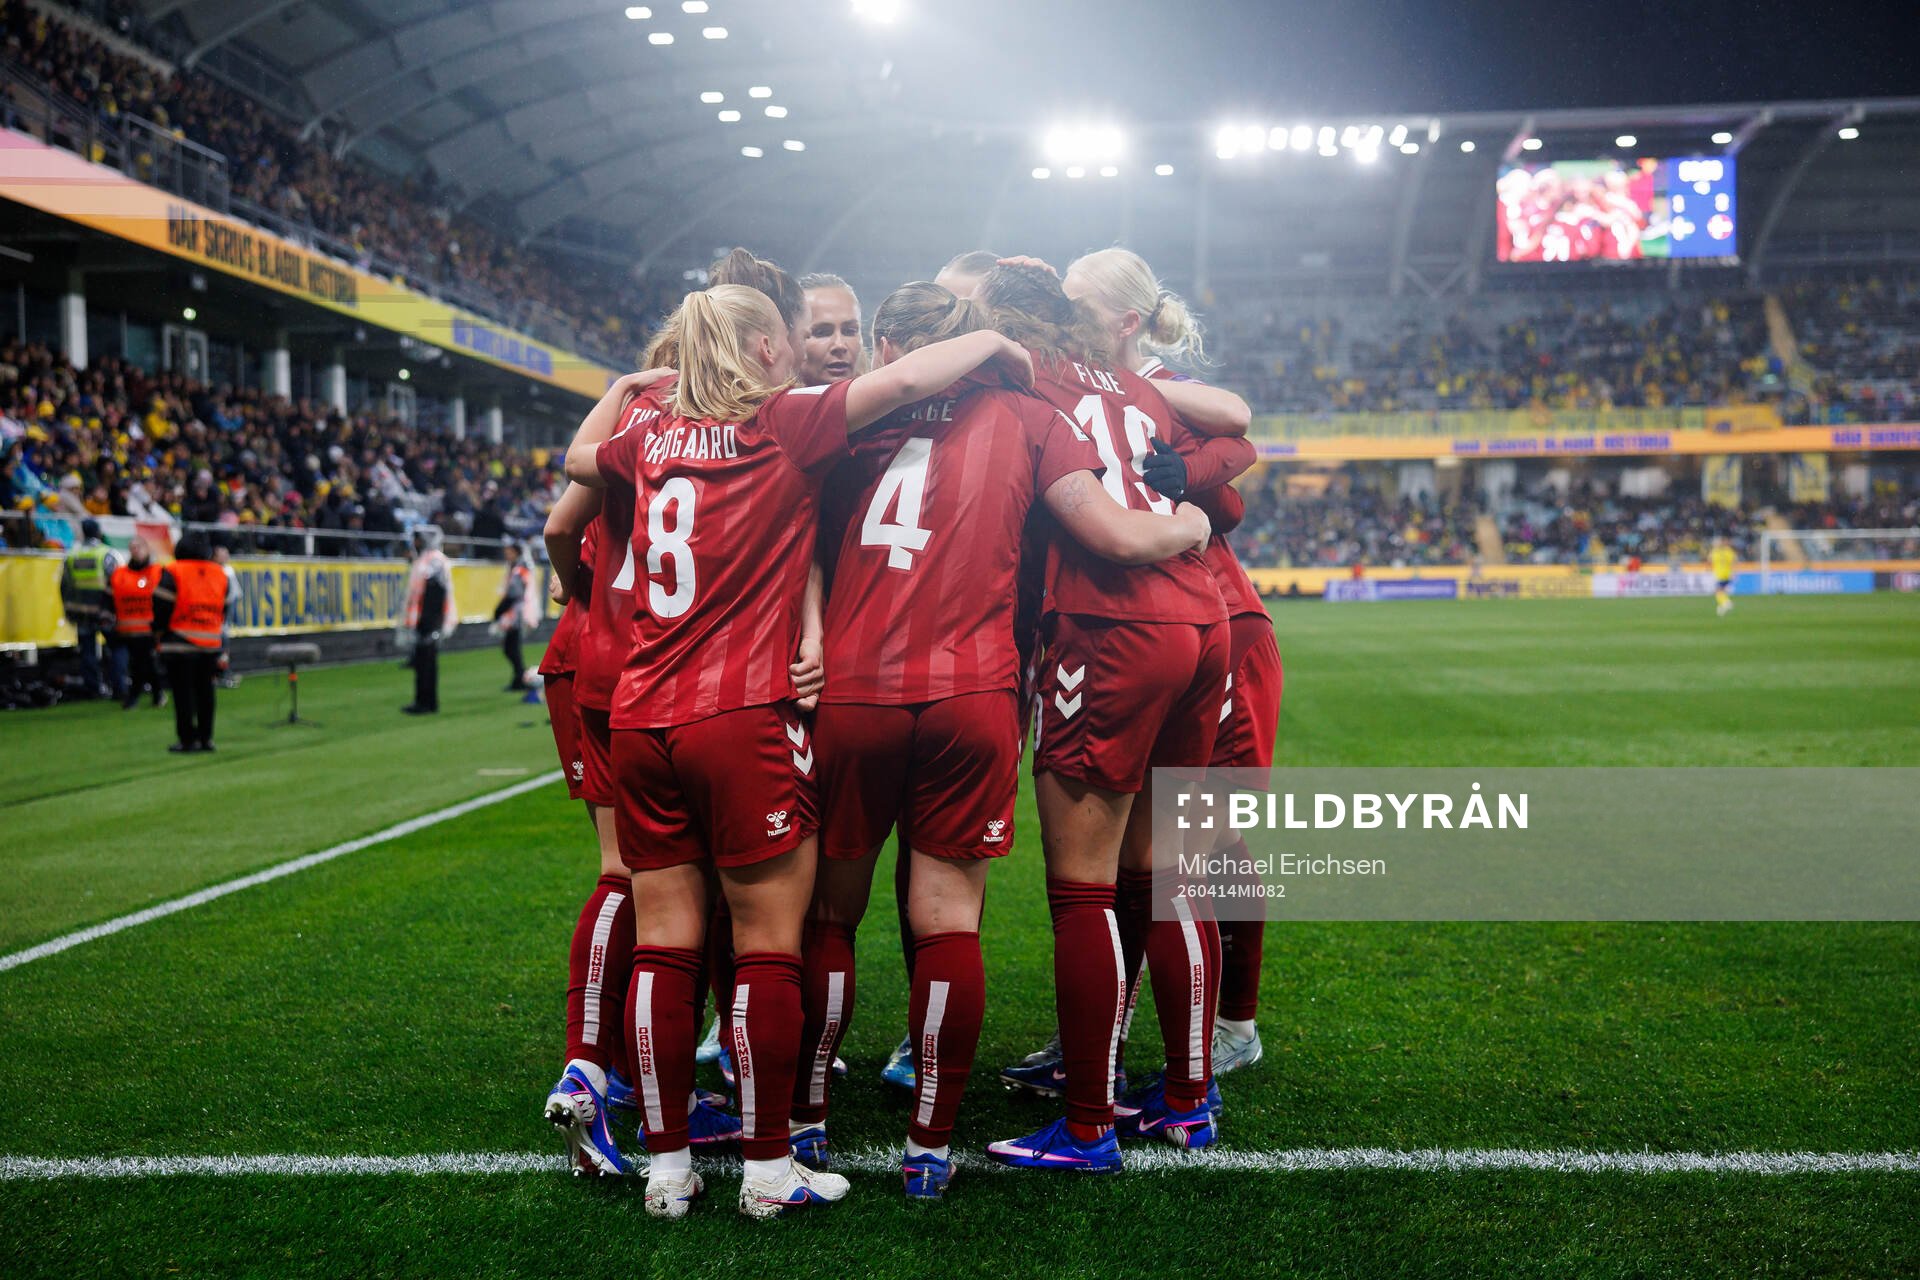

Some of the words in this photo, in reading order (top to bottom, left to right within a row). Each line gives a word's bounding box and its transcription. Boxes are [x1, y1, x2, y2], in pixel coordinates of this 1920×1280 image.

[646, 477, 697, 619] 8
[861, 437, 933, 571] 4
[639, 1026, 653, 1076] DANMARK
[735, 1026, 751, 1079] DANMARK
